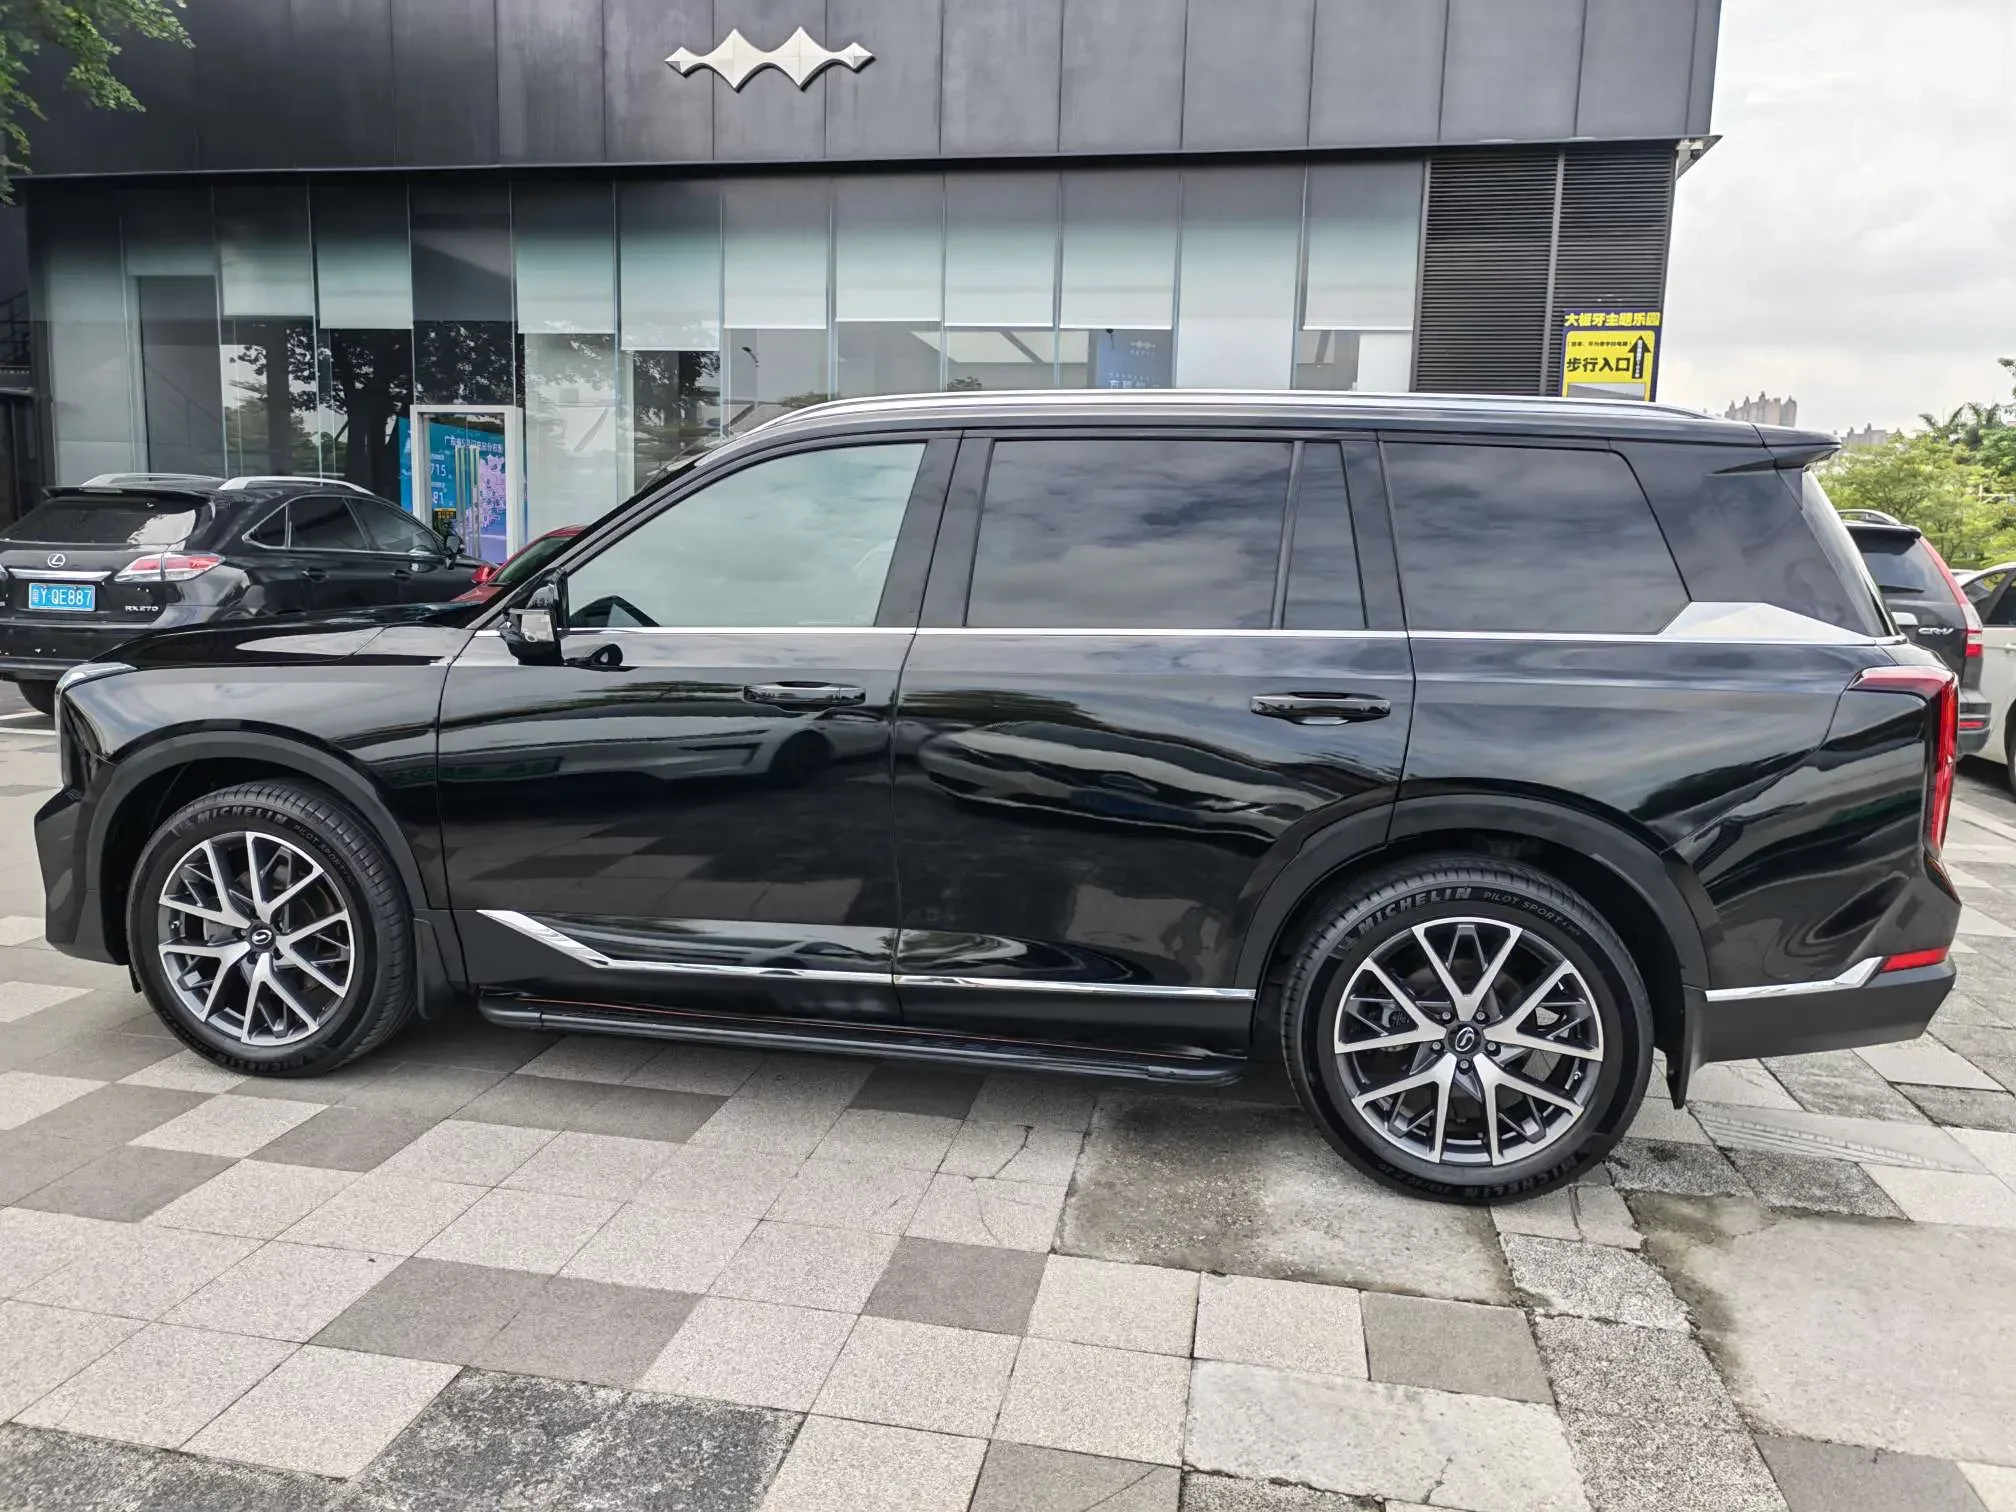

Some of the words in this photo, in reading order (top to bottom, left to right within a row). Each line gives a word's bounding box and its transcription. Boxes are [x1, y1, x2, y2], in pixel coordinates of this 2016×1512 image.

[1566, 357, 1631, 372] 步行入口
[197, 806, 289, 825] MICHELIN
[1358, 887, 1473, 935] MICHELIN
[1483, 891, 1520, 904] PILOT
[1522, 901, 1564, 922] SPORT
[1463, 1154, 1579, 1197] MICHELIN
